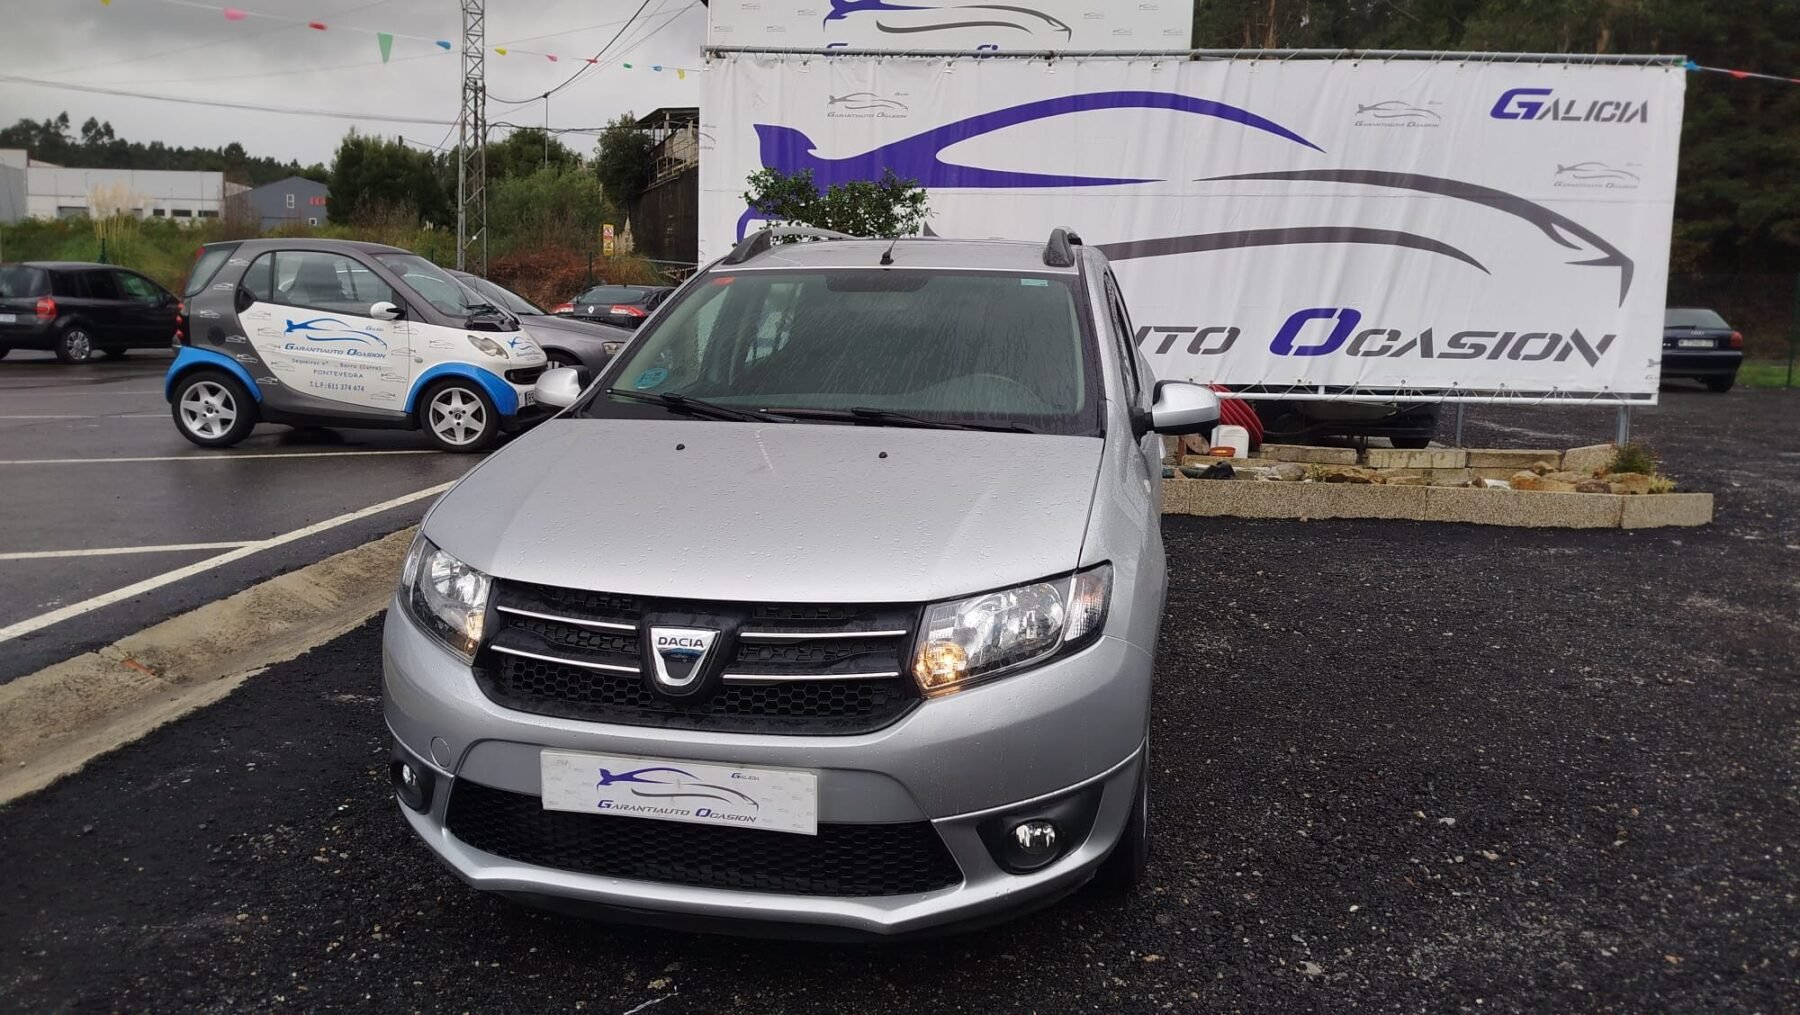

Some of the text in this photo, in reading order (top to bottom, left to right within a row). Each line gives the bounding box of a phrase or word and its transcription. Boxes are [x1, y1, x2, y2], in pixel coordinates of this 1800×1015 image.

[1490, 88, 1648, 123] GALICIA
[1269, 307, 1617, 368] OCASION
[285, 344, 343, 354] GARANTIAUTO
[313, 369, 364, 379] PONTEVEDRA
[658, 636, 704, 648] DACIA
[597, 800, 757, 822] GARANTIAUTO OCASION
